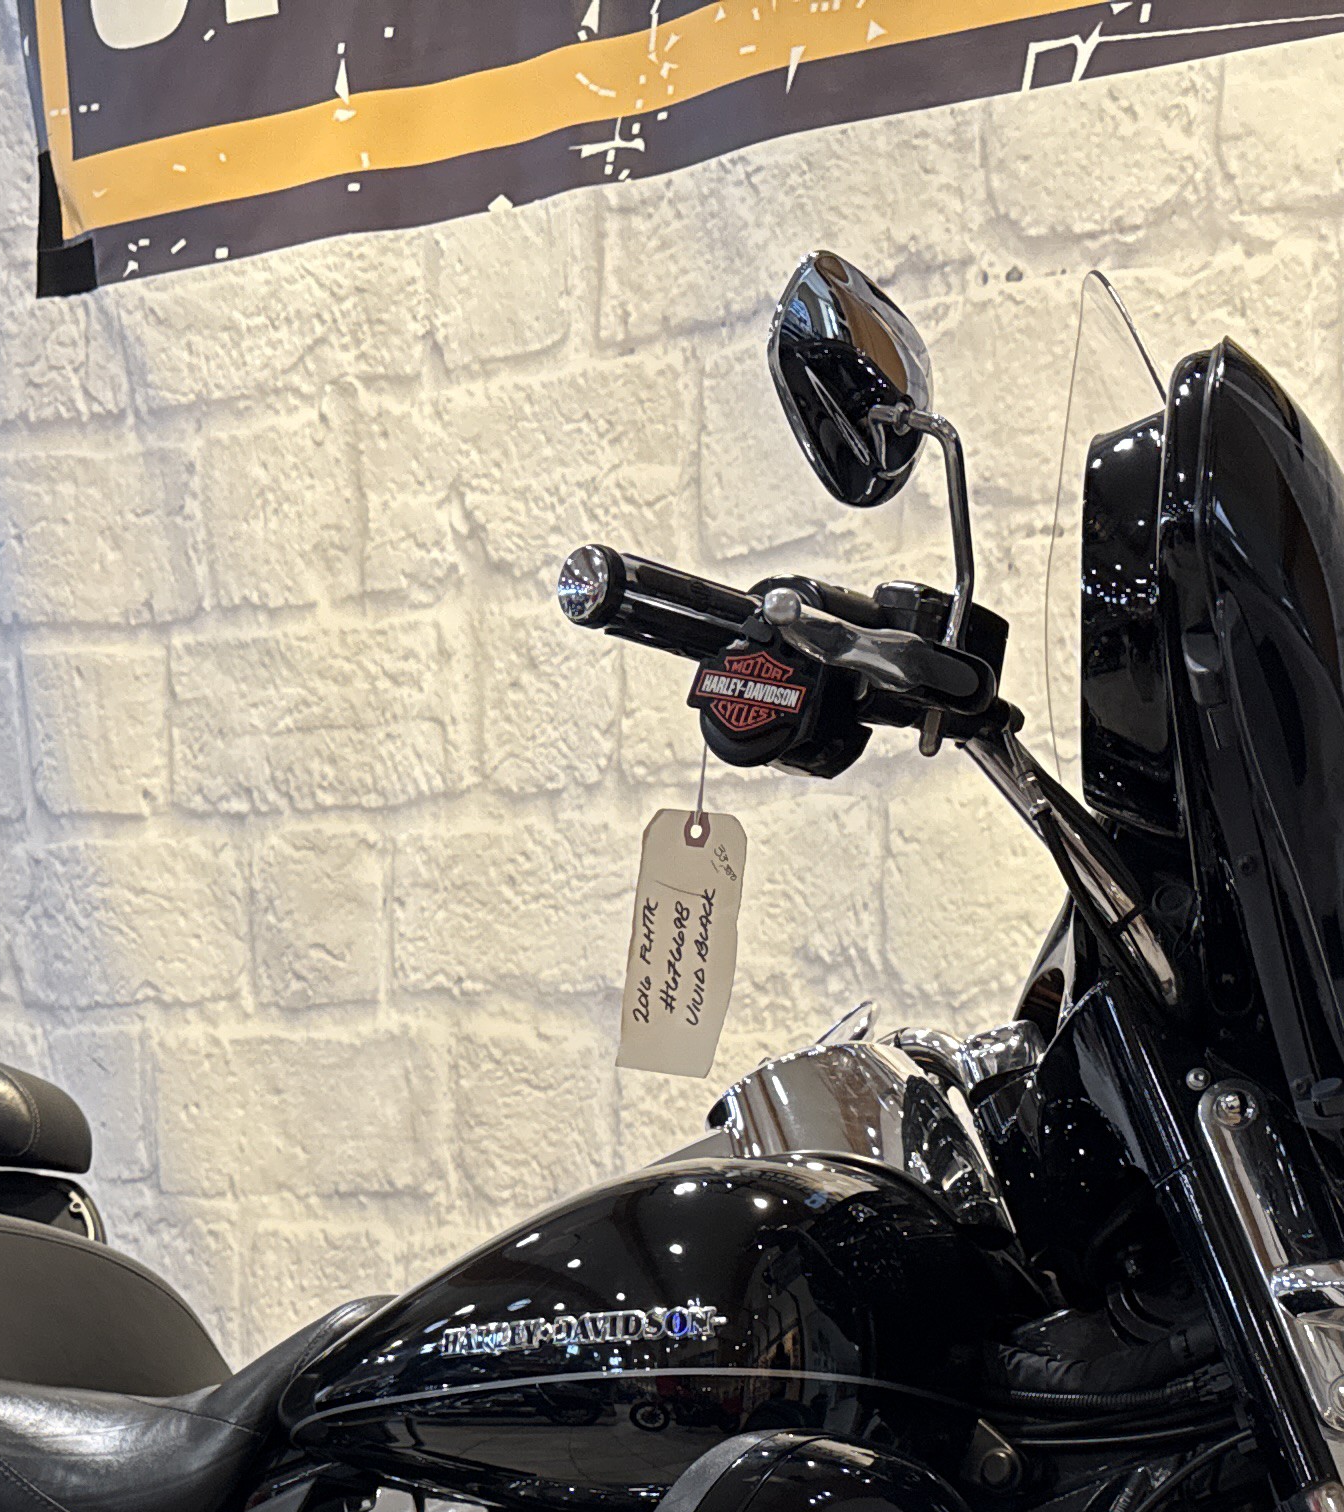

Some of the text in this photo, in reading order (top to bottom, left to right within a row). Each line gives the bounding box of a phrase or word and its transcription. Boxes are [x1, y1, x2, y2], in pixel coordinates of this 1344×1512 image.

[702, 675, 800, 707] HARLEY-DAVIDSON
[731, 658, 784, 680] MOTOR
[718, 701, 772, 726] CYCLES
[694, 888, 716, 963] BLACK
[632, 897, 659, 1024] 2016 FLHTK
[659, 900, 691, 1014] #676698
